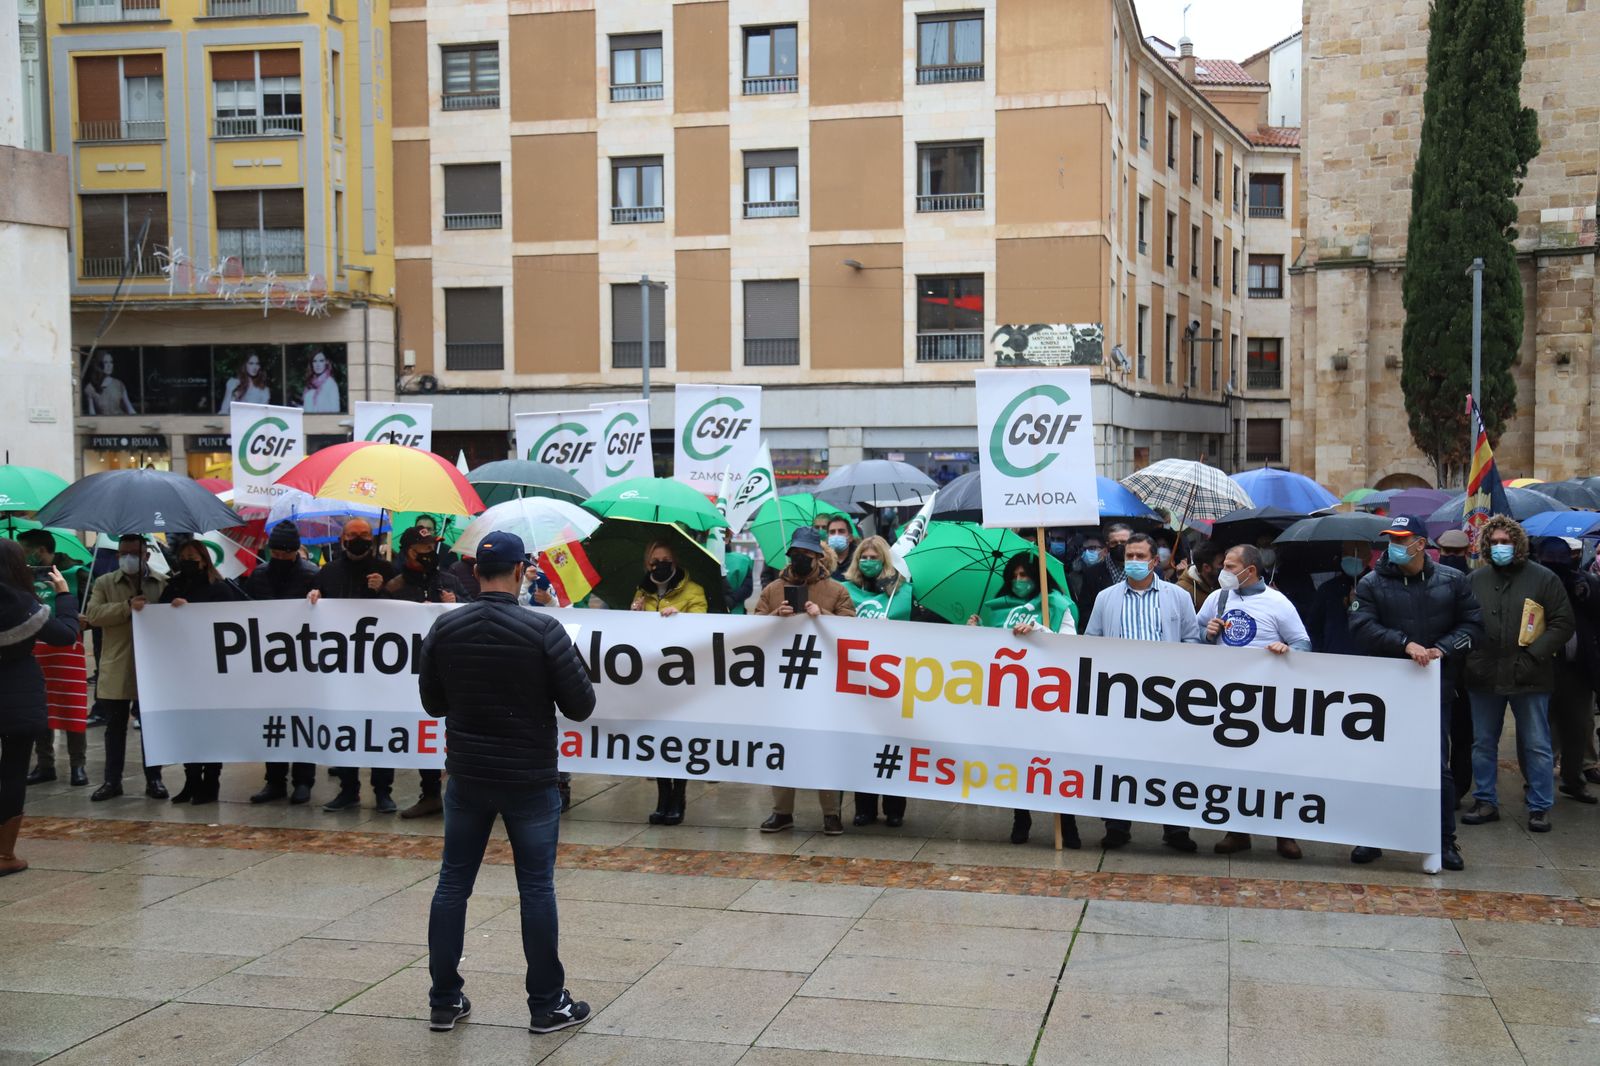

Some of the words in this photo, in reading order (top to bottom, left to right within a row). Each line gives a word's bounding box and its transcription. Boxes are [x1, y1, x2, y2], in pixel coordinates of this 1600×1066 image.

[696, 416, 753, 440] CSIF
[1008, 414, 1082, 446] CSIF
[131, 438, 159, 447] ROMA
[249, 434, 296, 458] CSIF
[541, 441, 597, 465] CSIF
[606, 432, 646, 456] CSIF
[1004, 492, 1077, 506] ZAMORA
[213, 616, 423, 675] Platafor
[657, 644, 696, 686] a
[712, 632, 766, 688] la
[778, 633, 1387, 749] #EspañaInsegura
[873, 743, 1327, 825] #EspañaInsegura
